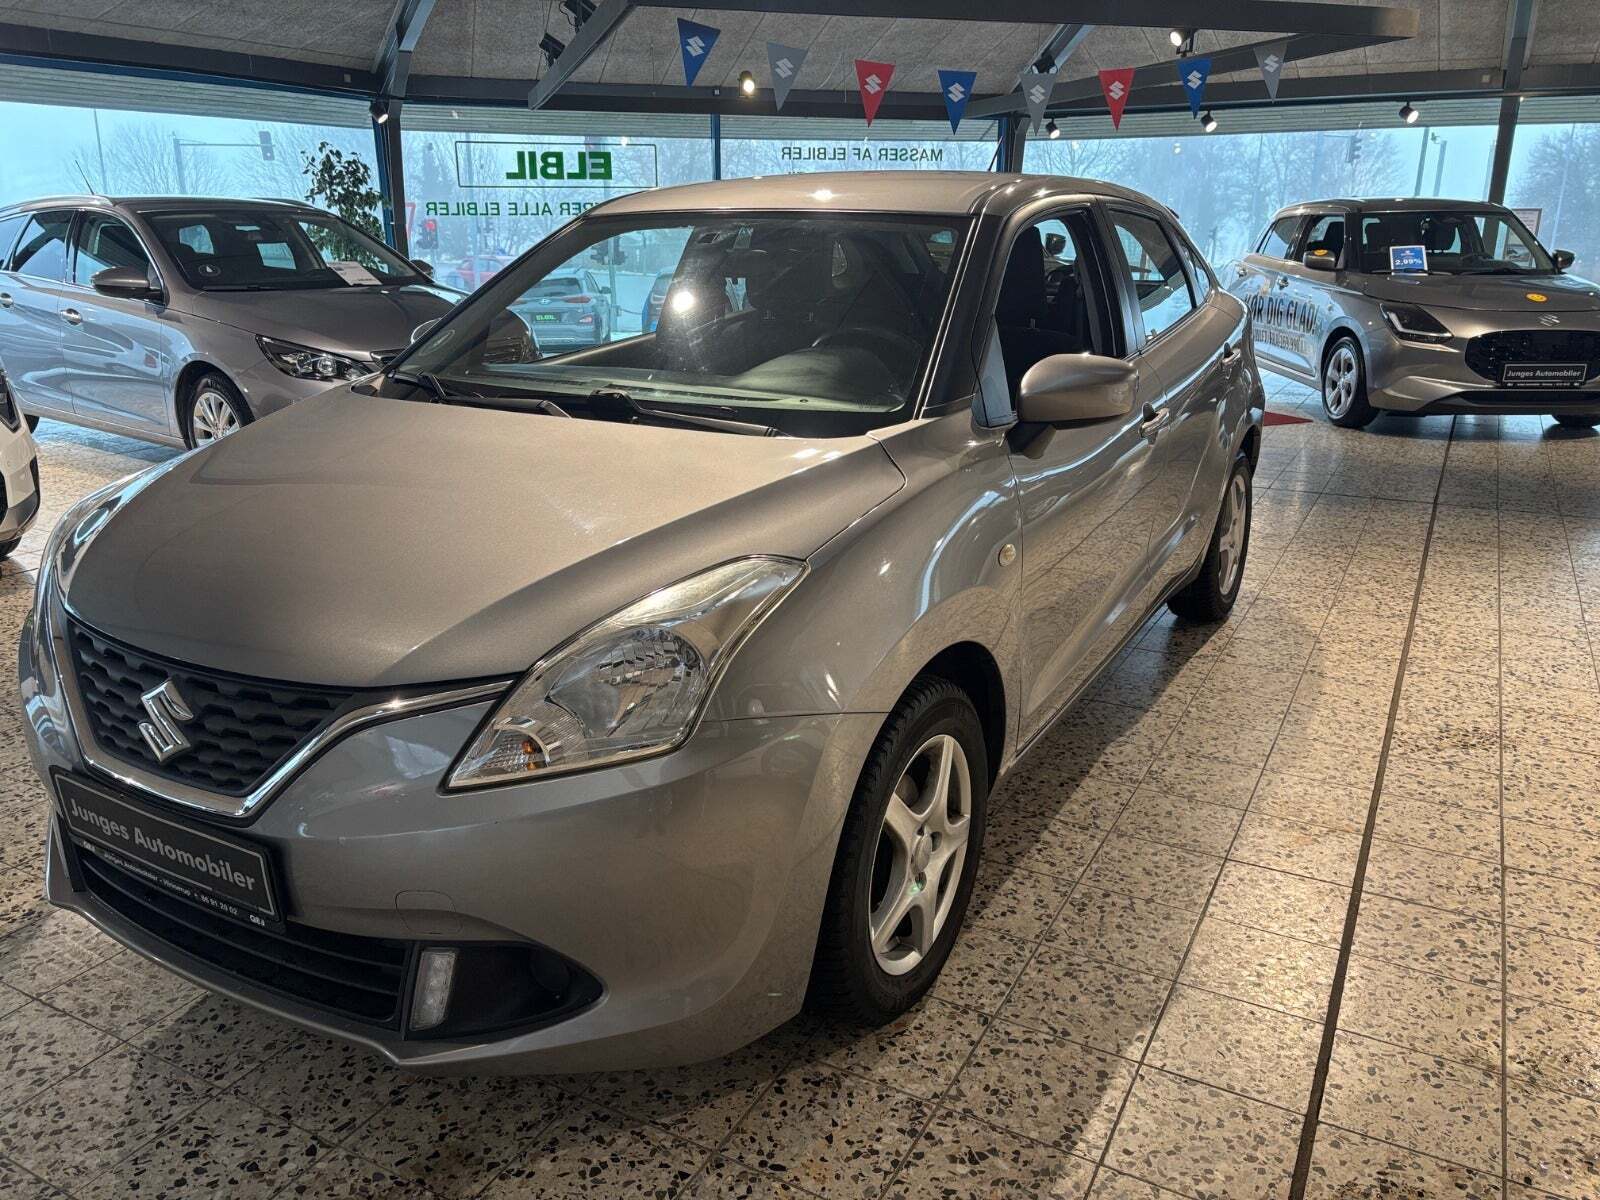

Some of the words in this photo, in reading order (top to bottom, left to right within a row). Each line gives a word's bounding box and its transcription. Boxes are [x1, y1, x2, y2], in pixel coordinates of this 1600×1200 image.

[1267, 296, 1284, 327] DIG
[1507, 369, 1534, 378] Junges
[1535, 369, 1582, 377] Automobiler
[71, 798, 129, 841] Junges
[134, 826, 256, 890] Automobiler
